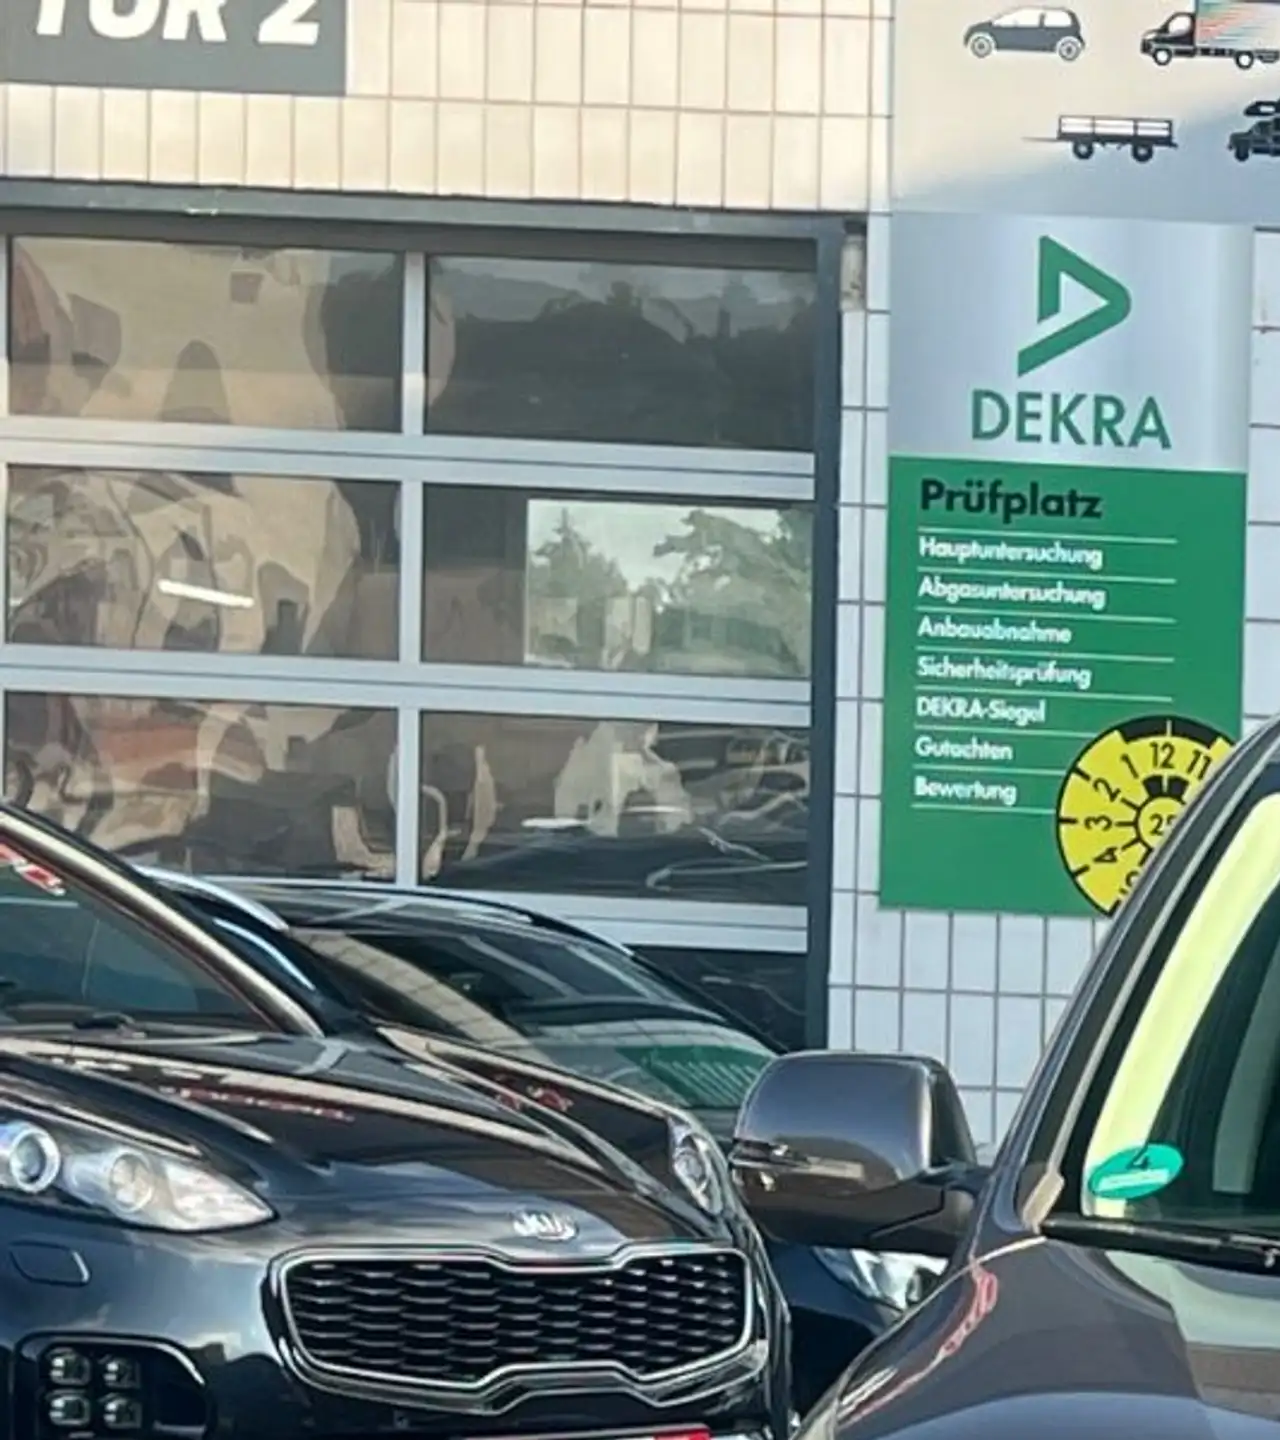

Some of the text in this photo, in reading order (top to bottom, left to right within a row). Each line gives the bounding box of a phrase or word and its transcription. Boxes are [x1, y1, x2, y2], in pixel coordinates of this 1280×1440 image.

[257, 0, 319, 45] 2
[972, 389, 1172, 449] DEKRA
[920, 479, 1104, 523] Prüfplatz
[919, 536, 1103, 570] Hauptuntersuchung
[918, 575, 1106, 610] Abgasuntersuchung
[917, 615, 1072, 644] Anbauabnahme
[916, 656, 1092, 690] Sicherheitsprüfung
[916, 696, 1046, 726] DEKRA-Siegel
[915, 736, 1013, 760] Gutachten
[1149, 741, 1175, 769] 12
[1120, 753, 1139, 779] 1
[1187, 749, 1212, 781] 11
[914, 776, 1017, 806] Bewertung
[1092, 777, 1121, 802] 2
[1084, 815, 1113, 831] 3
[1093, 846, 1117, 863] 4
